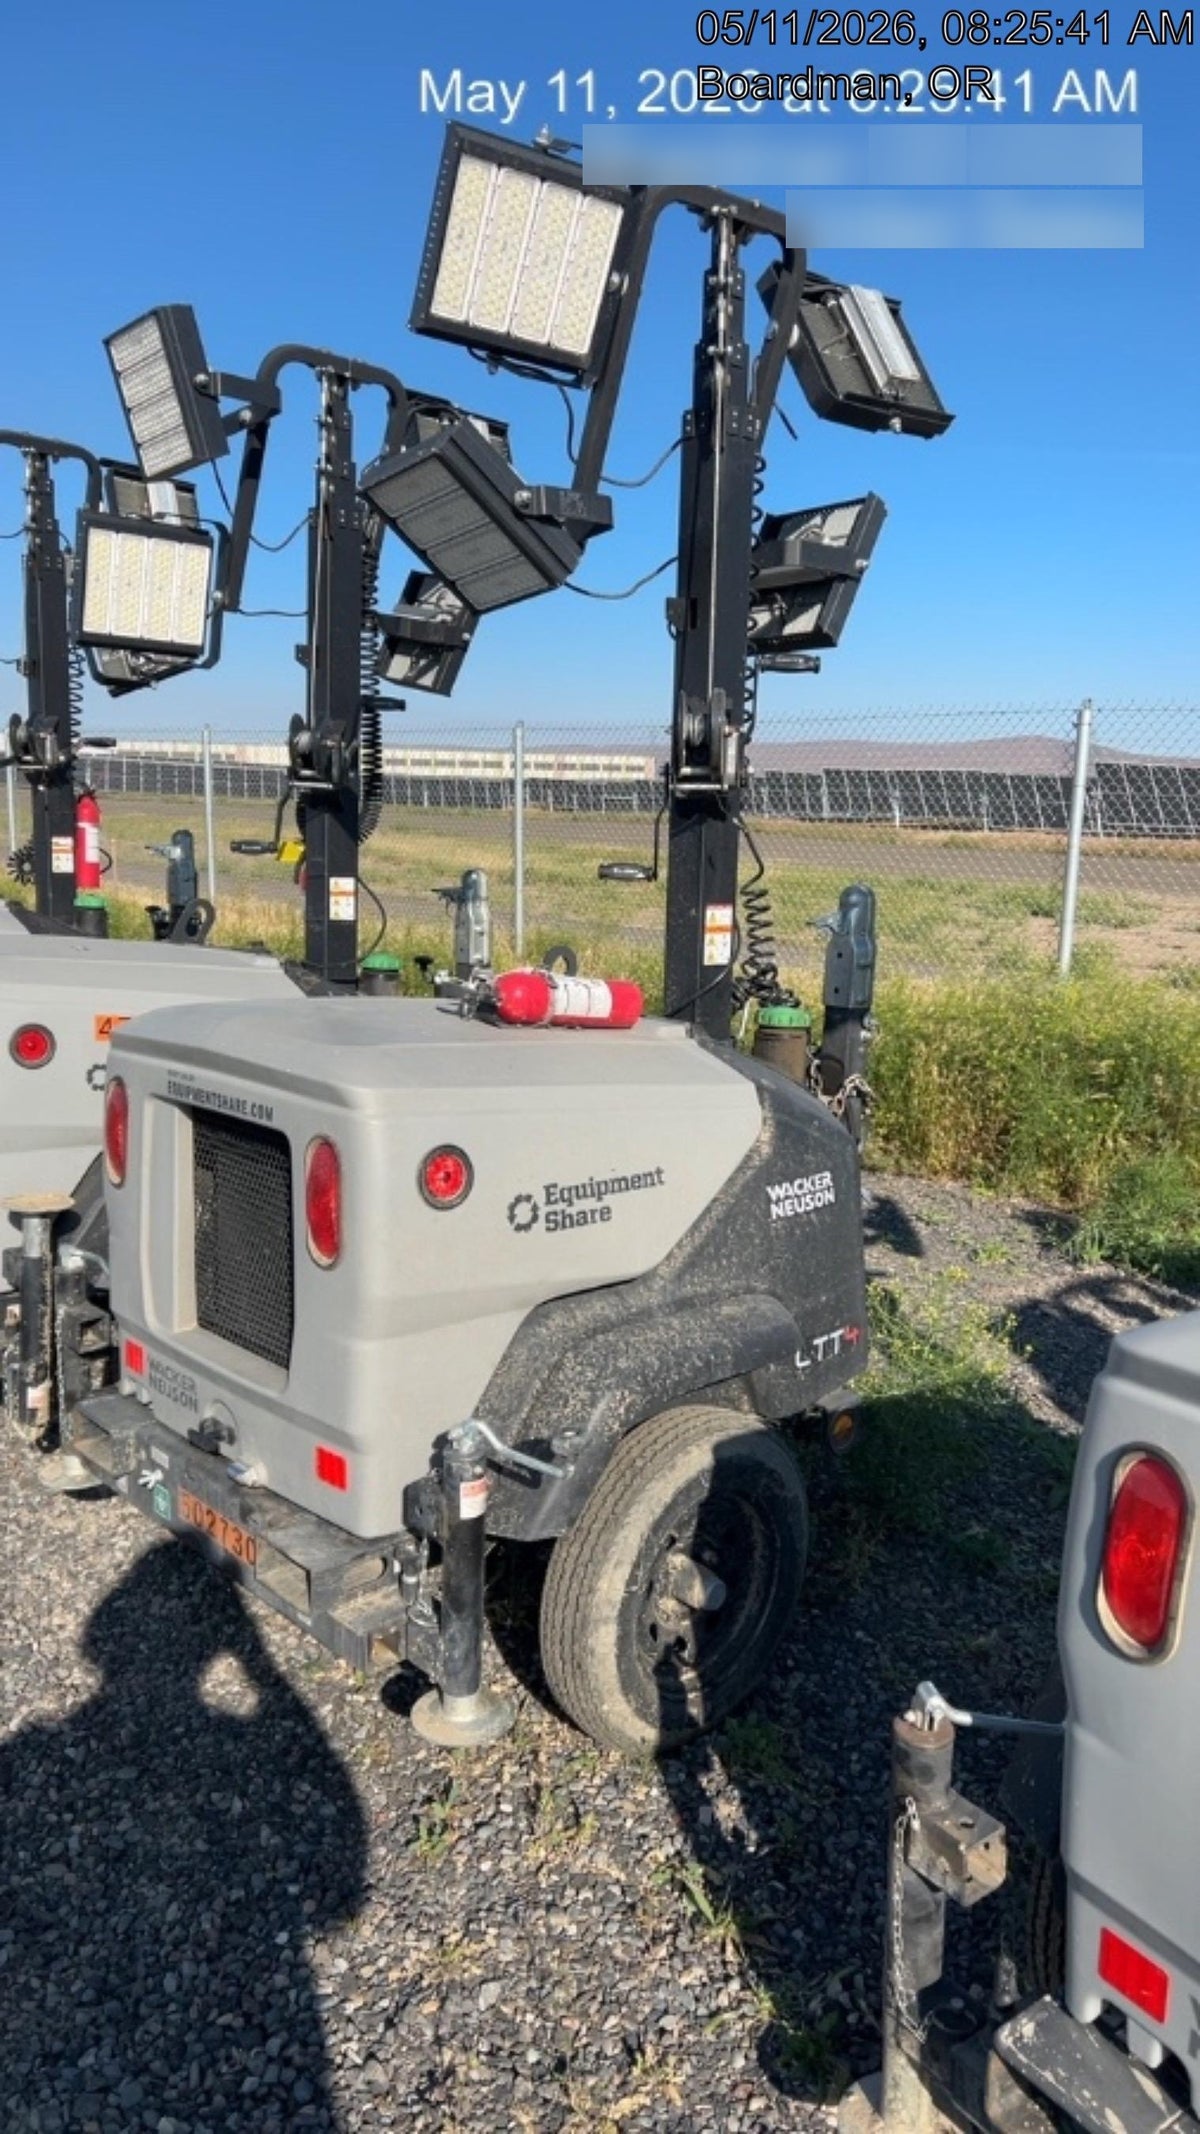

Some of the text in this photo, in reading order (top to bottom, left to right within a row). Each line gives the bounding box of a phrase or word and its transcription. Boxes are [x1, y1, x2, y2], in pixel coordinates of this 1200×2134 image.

[542, 1166, 665, 1206] Equipment
[766, 1170, 833, 1202] WACKER
[769, 1185, 836, 1220] NEUSON
[544, 1205, 613, 1233] Share
